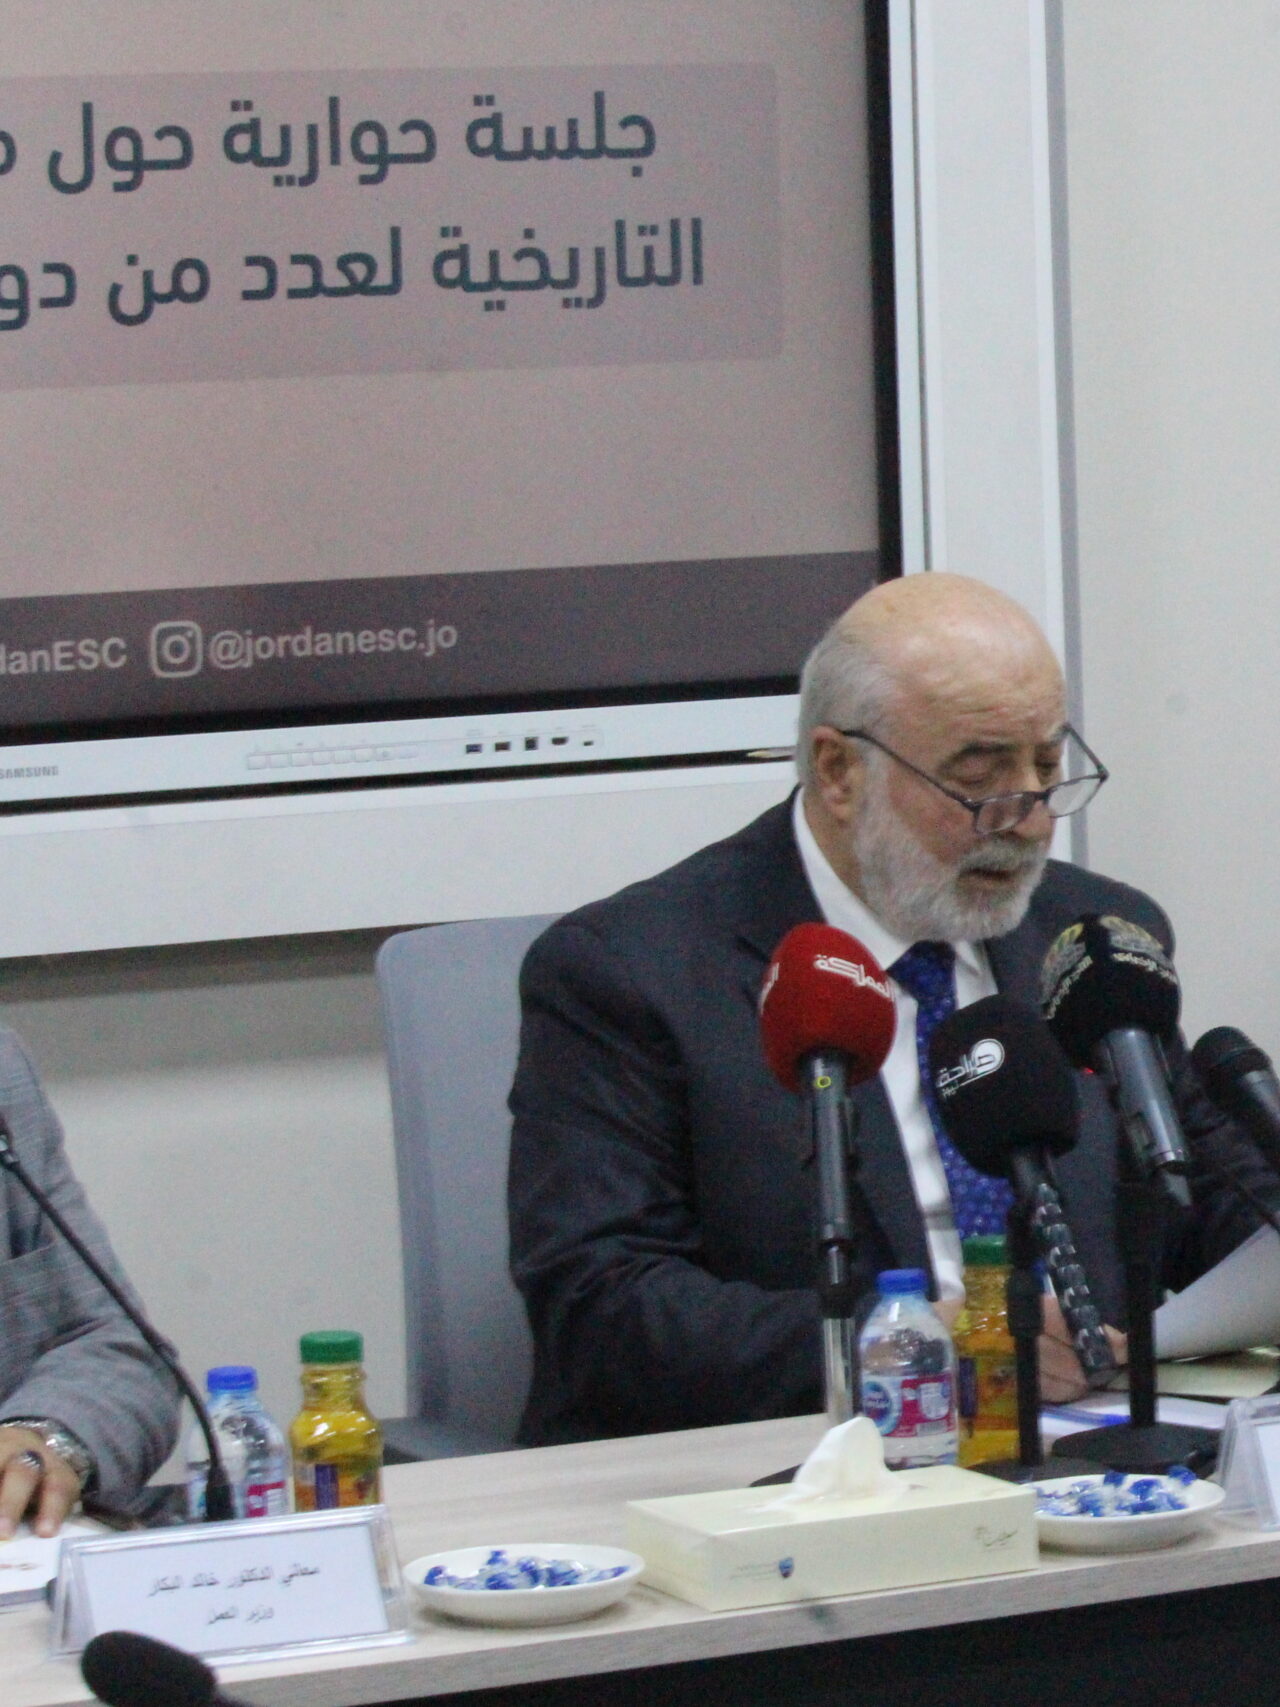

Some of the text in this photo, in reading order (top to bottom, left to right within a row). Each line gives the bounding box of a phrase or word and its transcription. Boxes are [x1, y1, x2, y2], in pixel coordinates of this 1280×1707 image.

[47, 101, 195, 194] حول
[222, 96, 438, 187] حوارية
[465, 90, 657, 178] جلسة
[107, 253, 211, 327] من
[241, 226, 403, 300] لعدد
[431, 217, 705, 312] التاريخية
[209, 618, 459, 670] @jordanesc.jo
